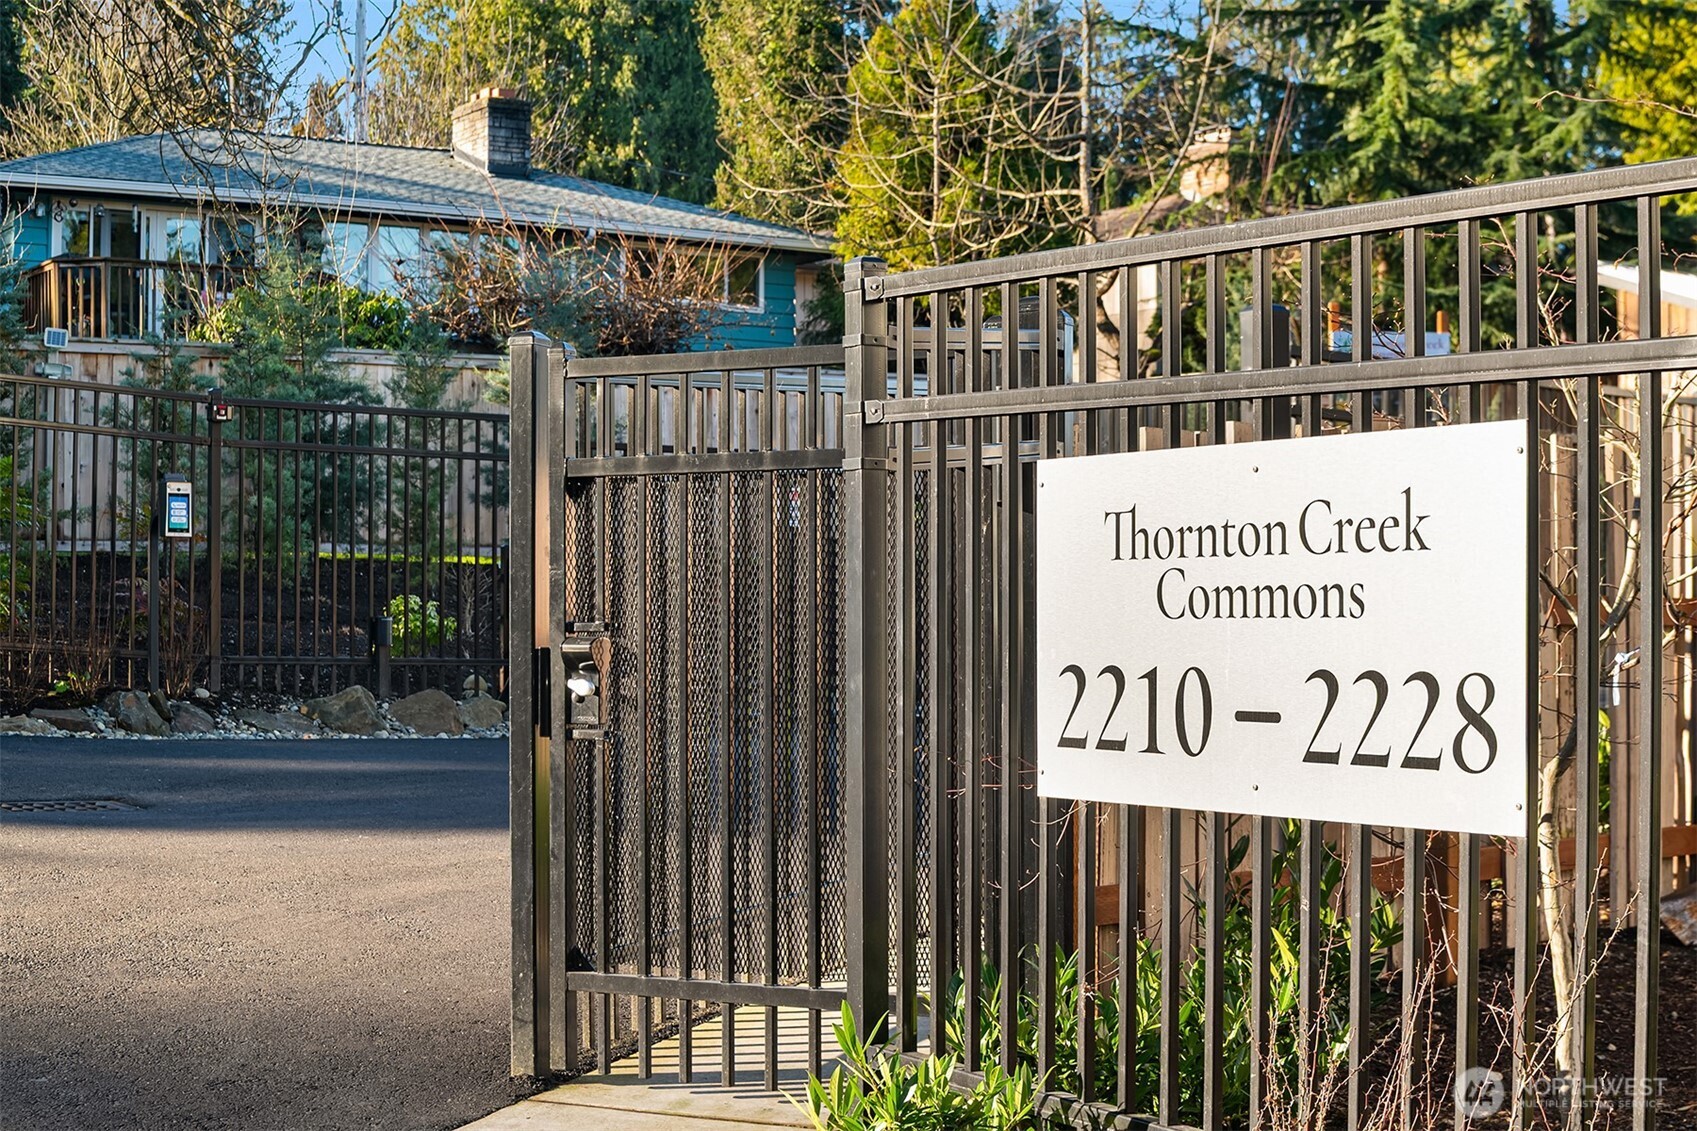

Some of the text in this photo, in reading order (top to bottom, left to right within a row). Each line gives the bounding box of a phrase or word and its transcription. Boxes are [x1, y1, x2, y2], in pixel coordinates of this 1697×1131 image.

[1104, 486, 1432, 561] Thornton Creek
[1156, 567, 1365, 620] Commons
[1057, 664, 1213, 758] 2210
[1302, 668, 1498, 775] 2228
